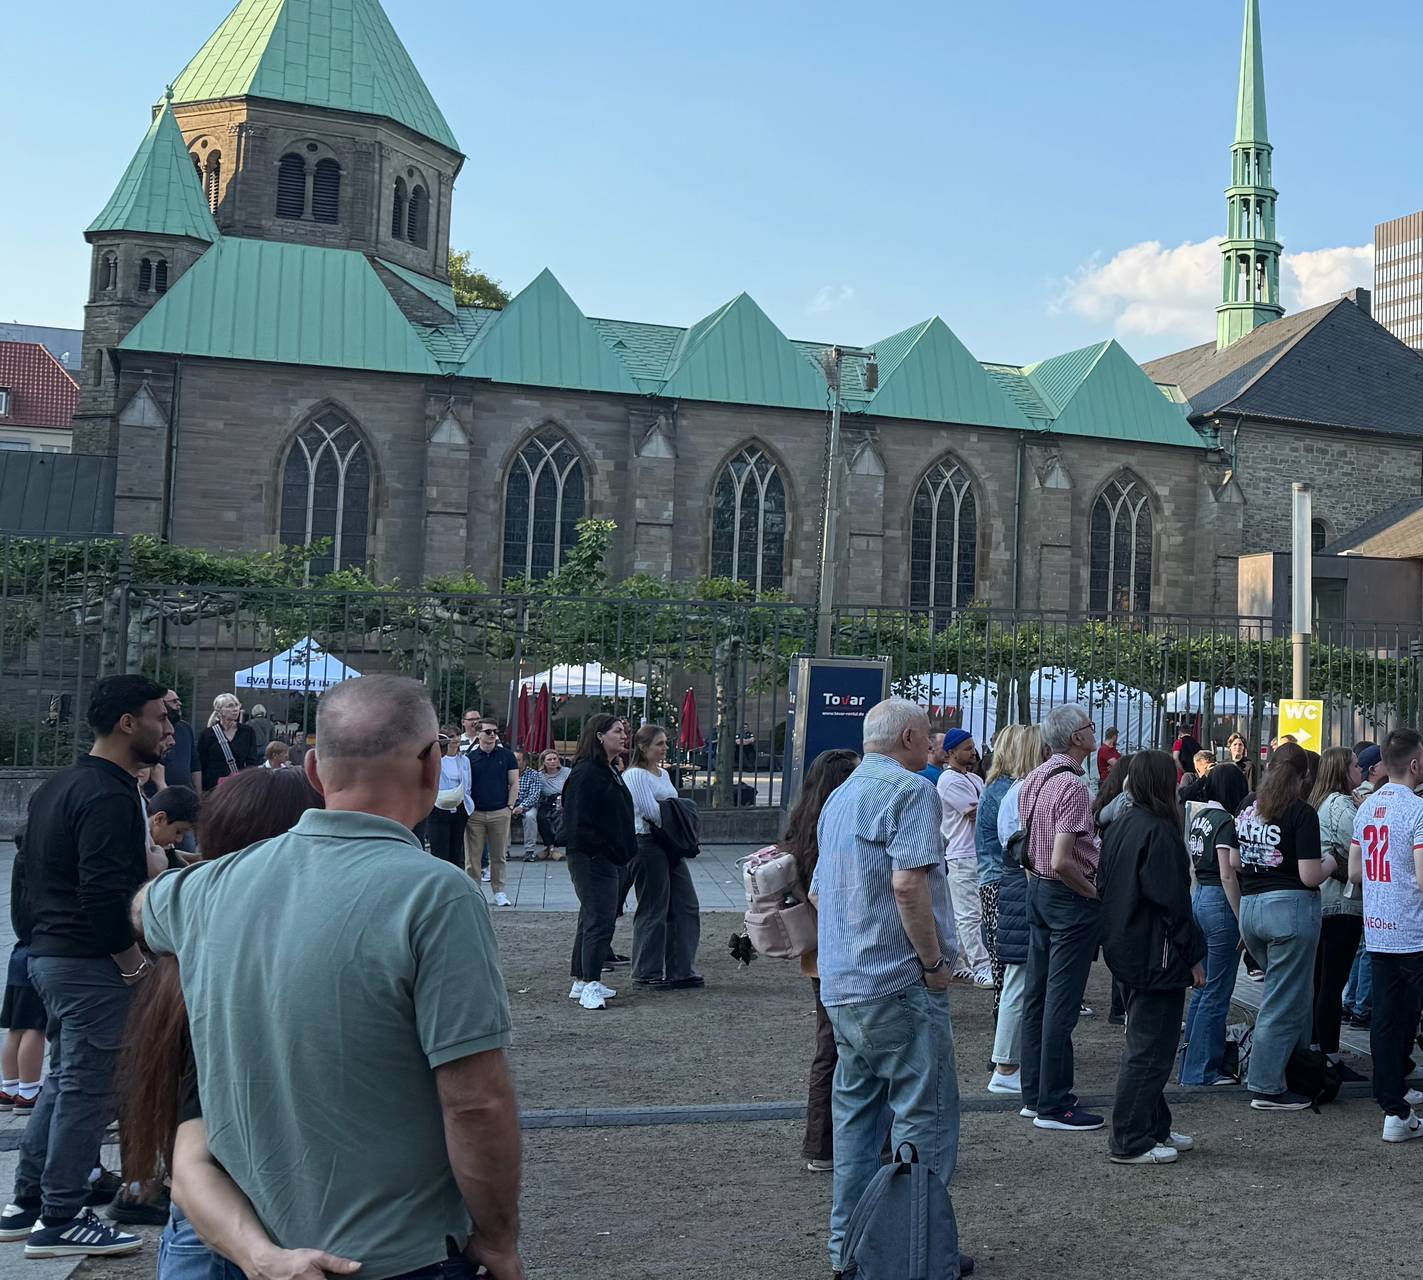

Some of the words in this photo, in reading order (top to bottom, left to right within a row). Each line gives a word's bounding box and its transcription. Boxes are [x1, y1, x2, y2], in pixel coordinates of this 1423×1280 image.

[823, 693, 865, 706] Tovar
[1285, 704, 1318, 720] WC
[1363, 824, 1391, 883] 32
